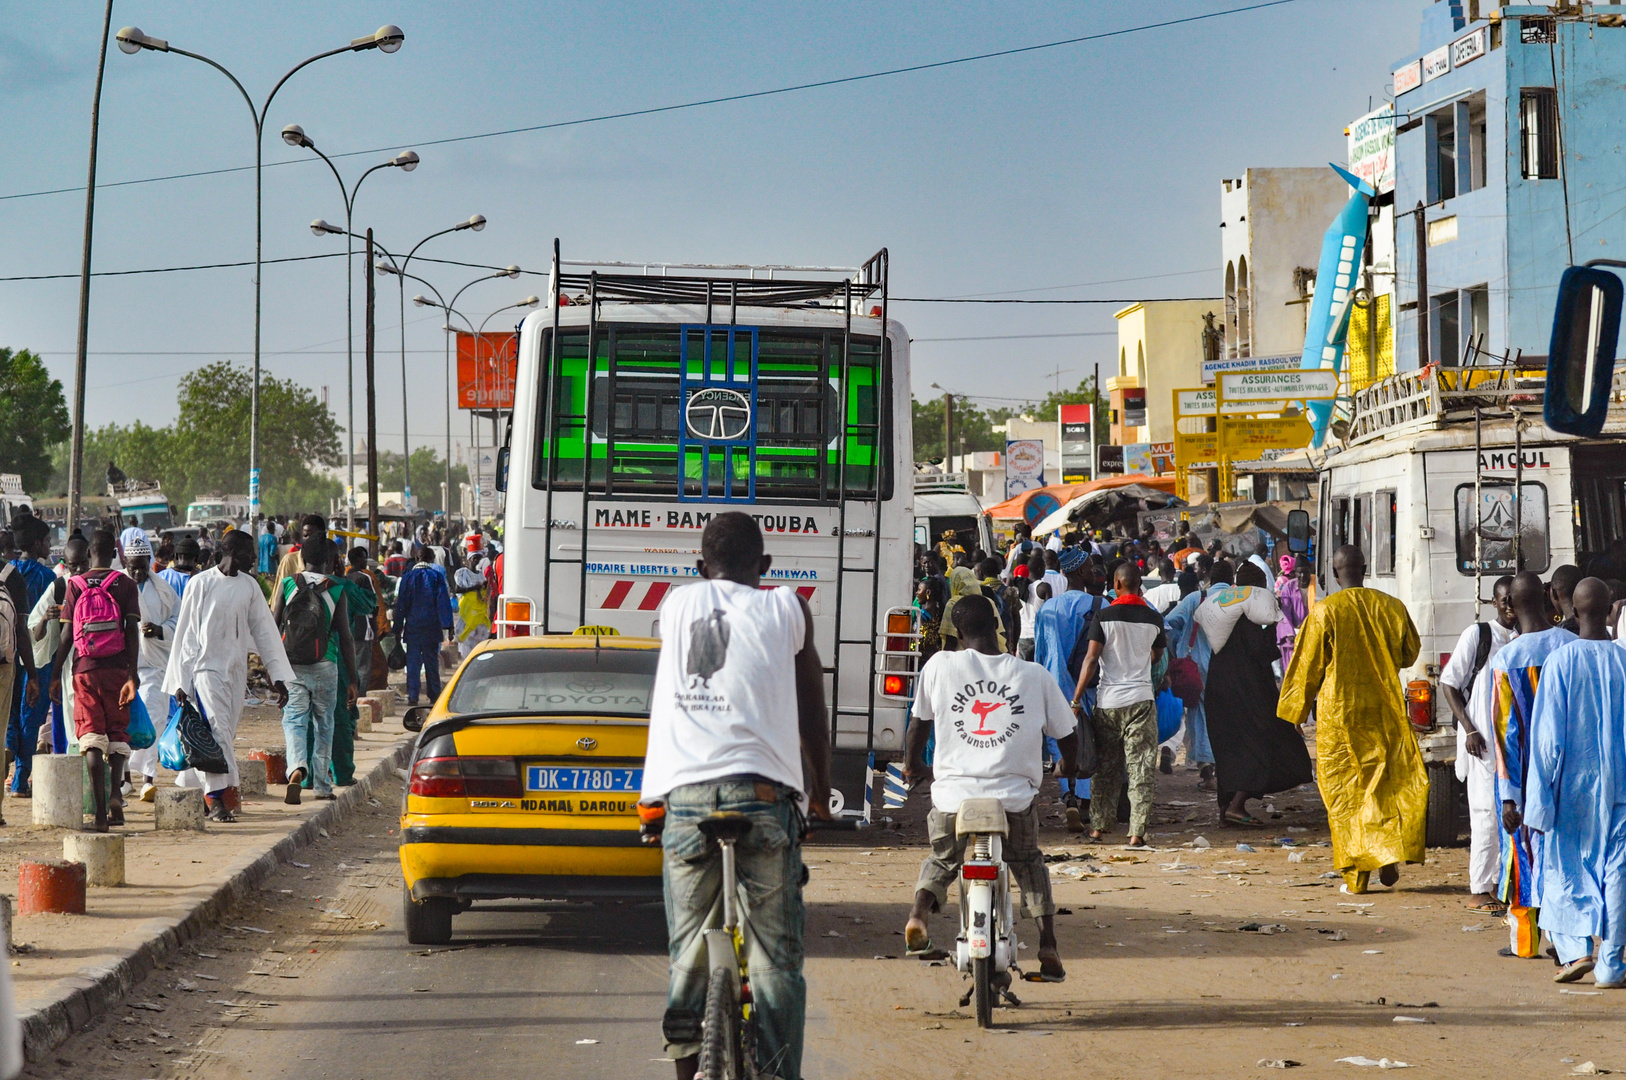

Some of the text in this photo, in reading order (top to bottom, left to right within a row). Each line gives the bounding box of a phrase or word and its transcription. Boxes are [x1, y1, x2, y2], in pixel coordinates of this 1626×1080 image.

[1205, 361, 1230, 371] AGENCE
[1259, 357, 1288, 366] RASSOUL
[1290, 355, 1302, 363] VOY
[1241, 374, 1302, 384] ASSURANCES
[1195, 391, 1217, 400] ASSU
[1228, 386, 1246, 394] TOUTES
[1247, 386, 1271, 394] BRANCHES
[1201, 401, 1217, 409] BRANC
[1151, 443, 1175, 453] MU
[595, 508, 819, 534] MAME BAM TOUBA
[586, 562, 626, 574] HORAIRE
[630, 564, 670, 575] LIBERTE
[684, 566, 700, 577] TO
[770, 569, 818, 580] KHEWAR
[578, 627, 614, 635] TAXI
[530, 693, 644, 705] TOYOTA
[951, 679, 1025, 716] SHOTOKAN
[954, 719, 1020, 749] Braunschweig
[579, 801, 627, 812] DAROU
